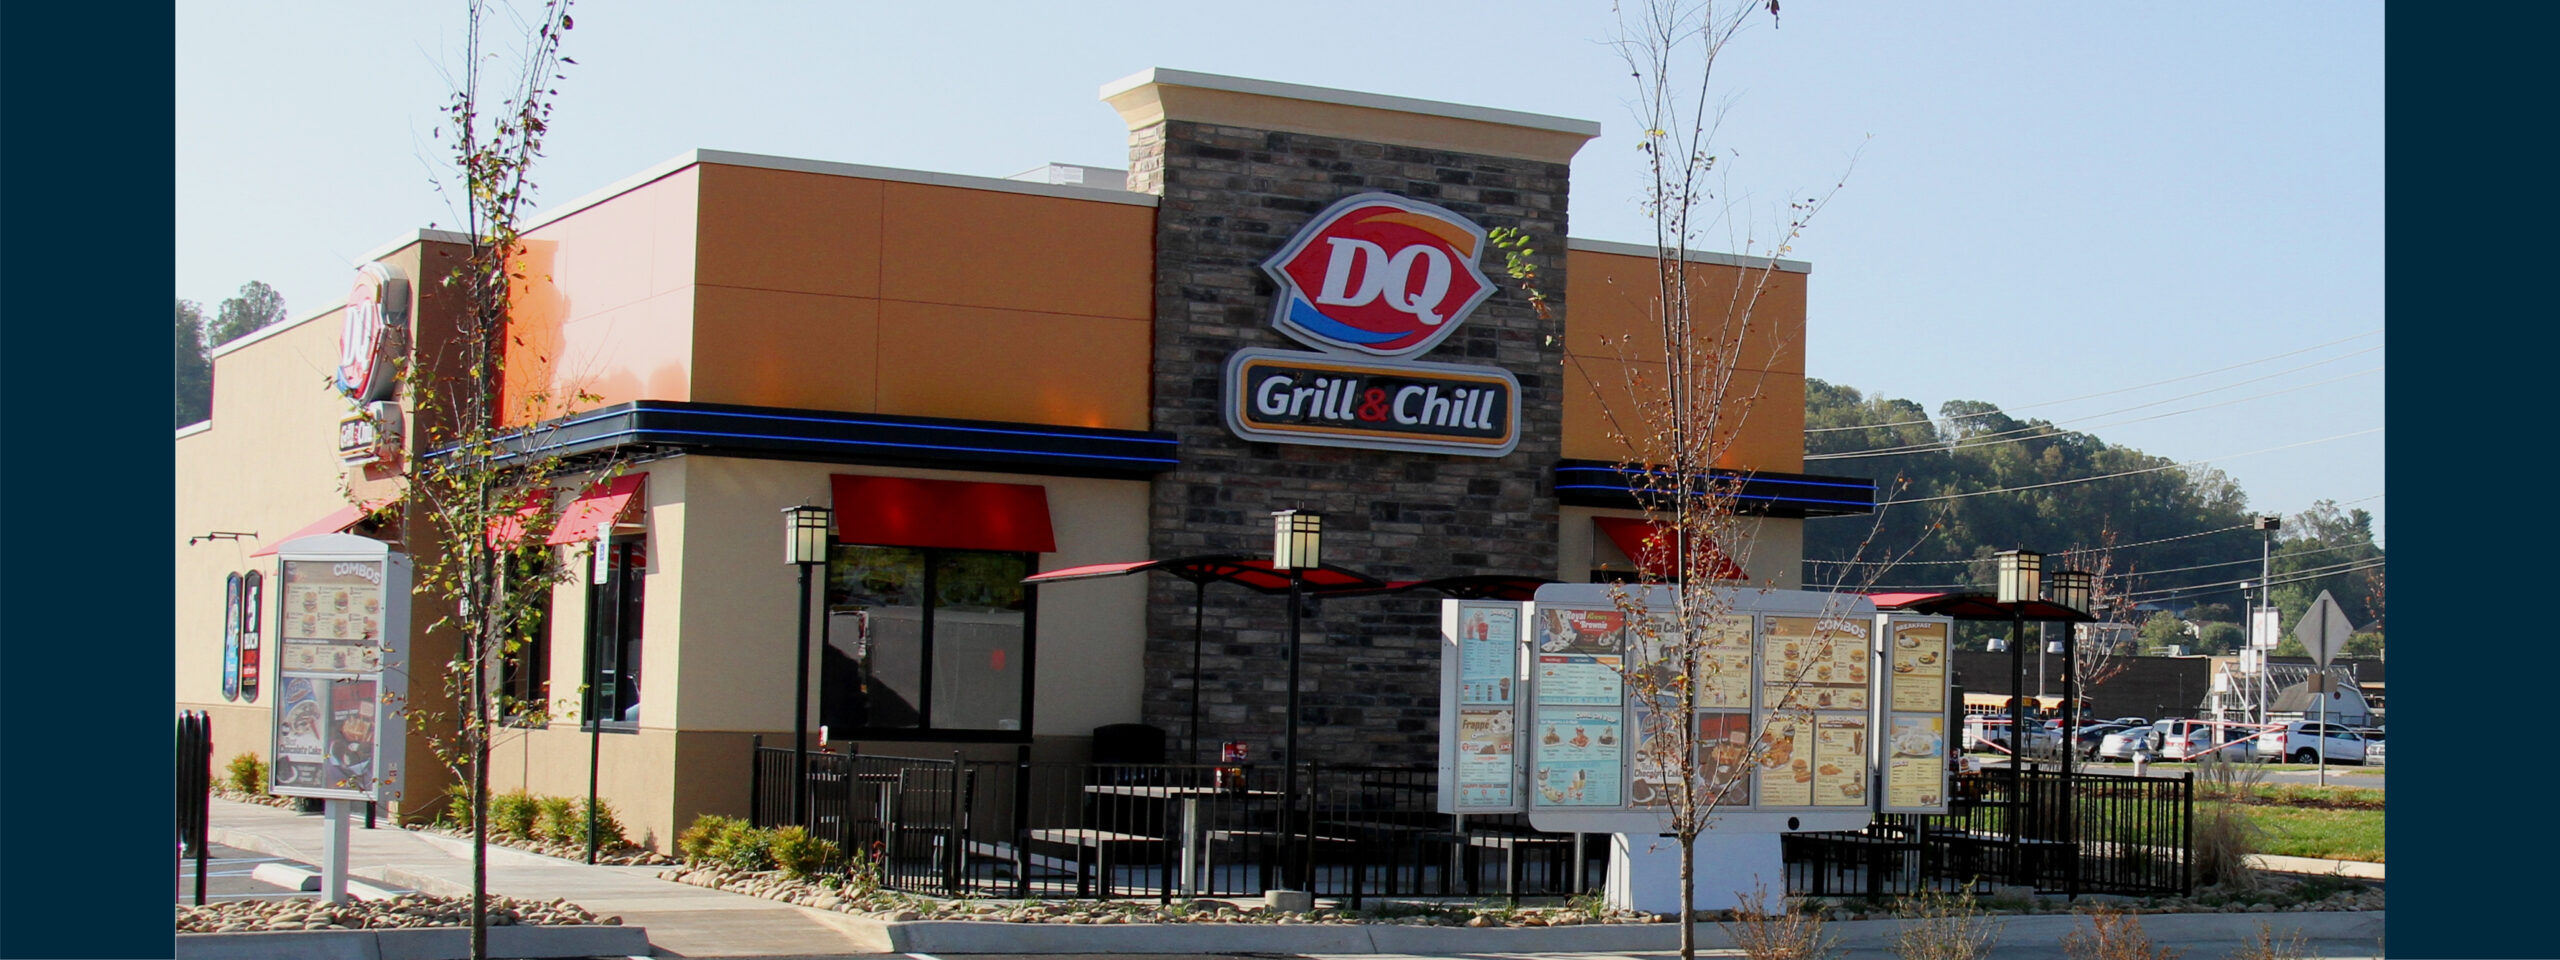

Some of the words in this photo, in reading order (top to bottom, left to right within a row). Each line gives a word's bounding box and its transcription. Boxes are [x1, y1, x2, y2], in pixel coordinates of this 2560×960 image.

[1316, 236, 1452, 325] DQ
[343, 299, 373, 373] DQ
[333, 562, 381, 585] COMBOS
[1579, 620, 1608, 629] Brownie
[1817, 618, 1867, 639] COMBOS
[1895, 622, 1932, 633] BREAKFAST
[1462, 718, 1490, 732] Frappé
[279, 743, 308, 754] Chocolate
[308, 744, 322, 755] Cake
